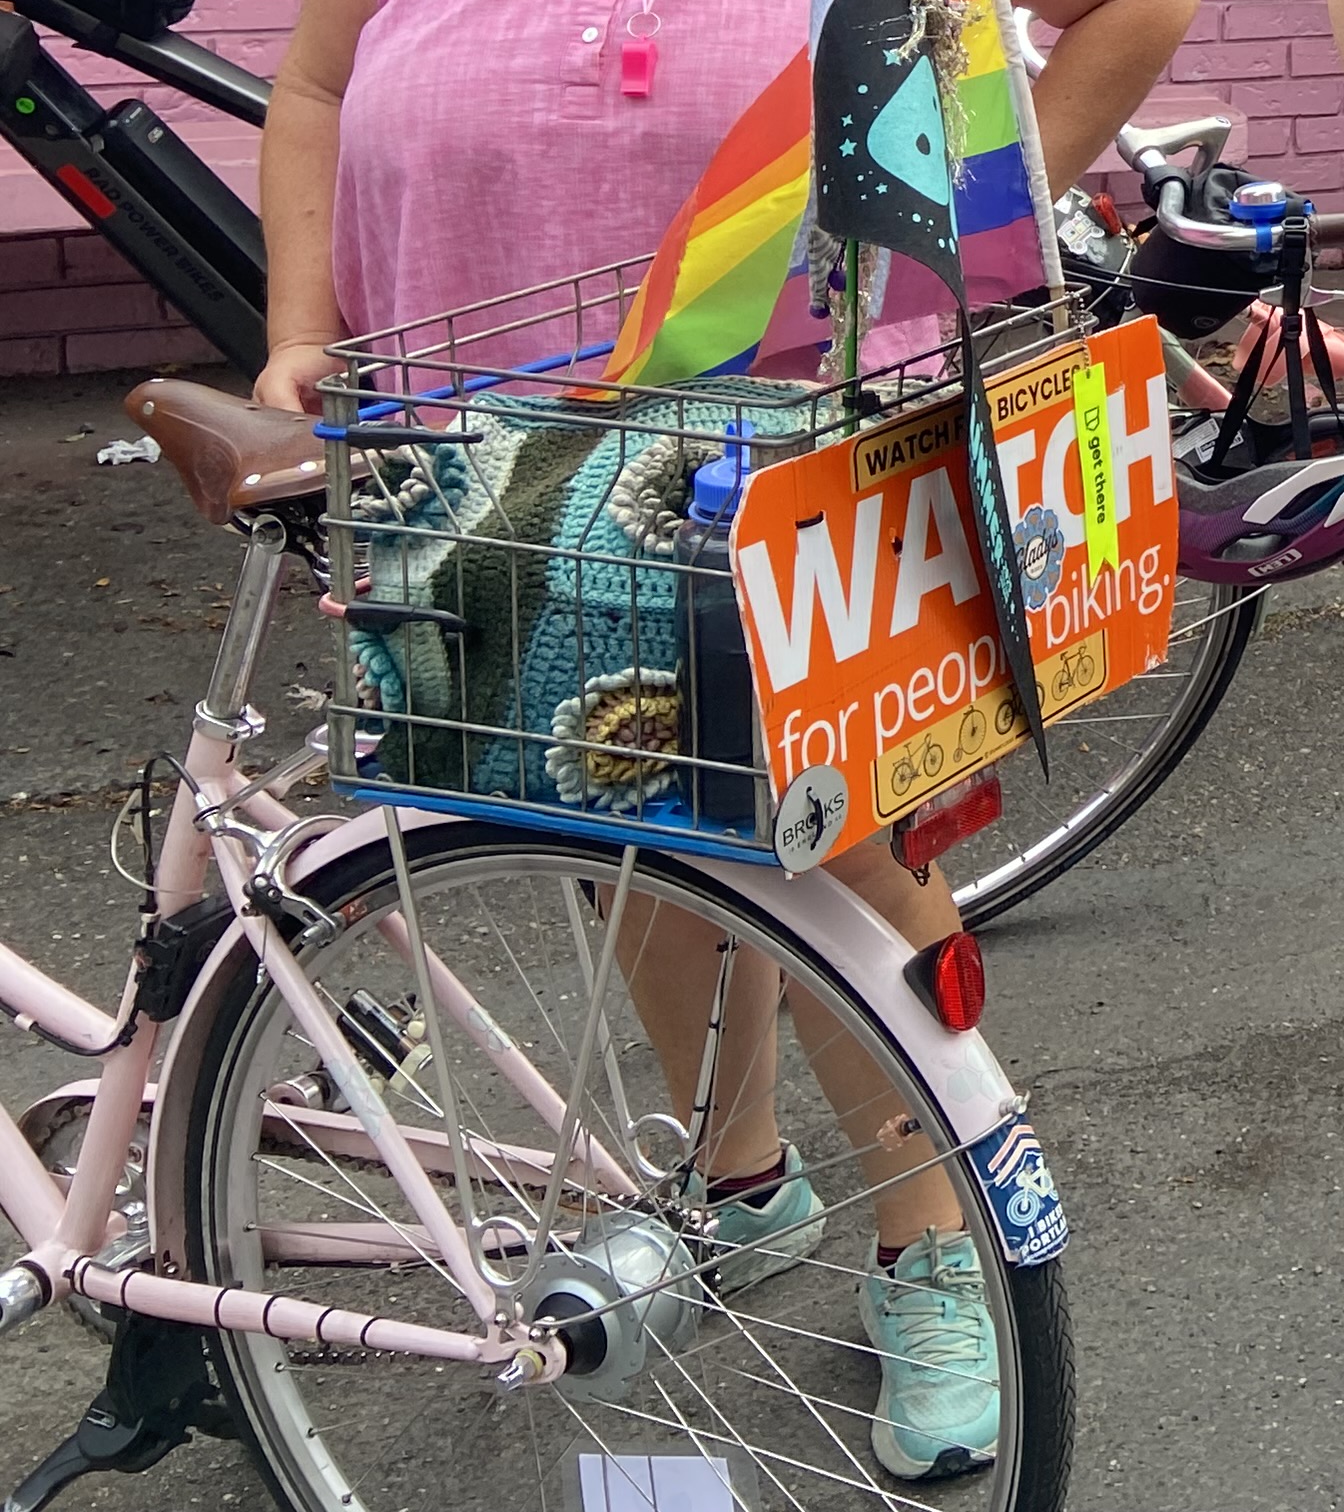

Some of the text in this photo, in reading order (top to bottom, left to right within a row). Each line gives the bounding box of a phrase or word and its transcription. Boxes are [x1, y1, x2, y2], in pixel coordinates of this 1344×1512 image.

[120, 201, 179, 257] POWER
[865, 424, 950, 476] WATCH
[1087, 436, 1107, 525] get there
[738, 373, 1175, 695] WATCH
[778, 544, 1170, 788] for peop biking.
[783, 792, 846, 848] BROKS
